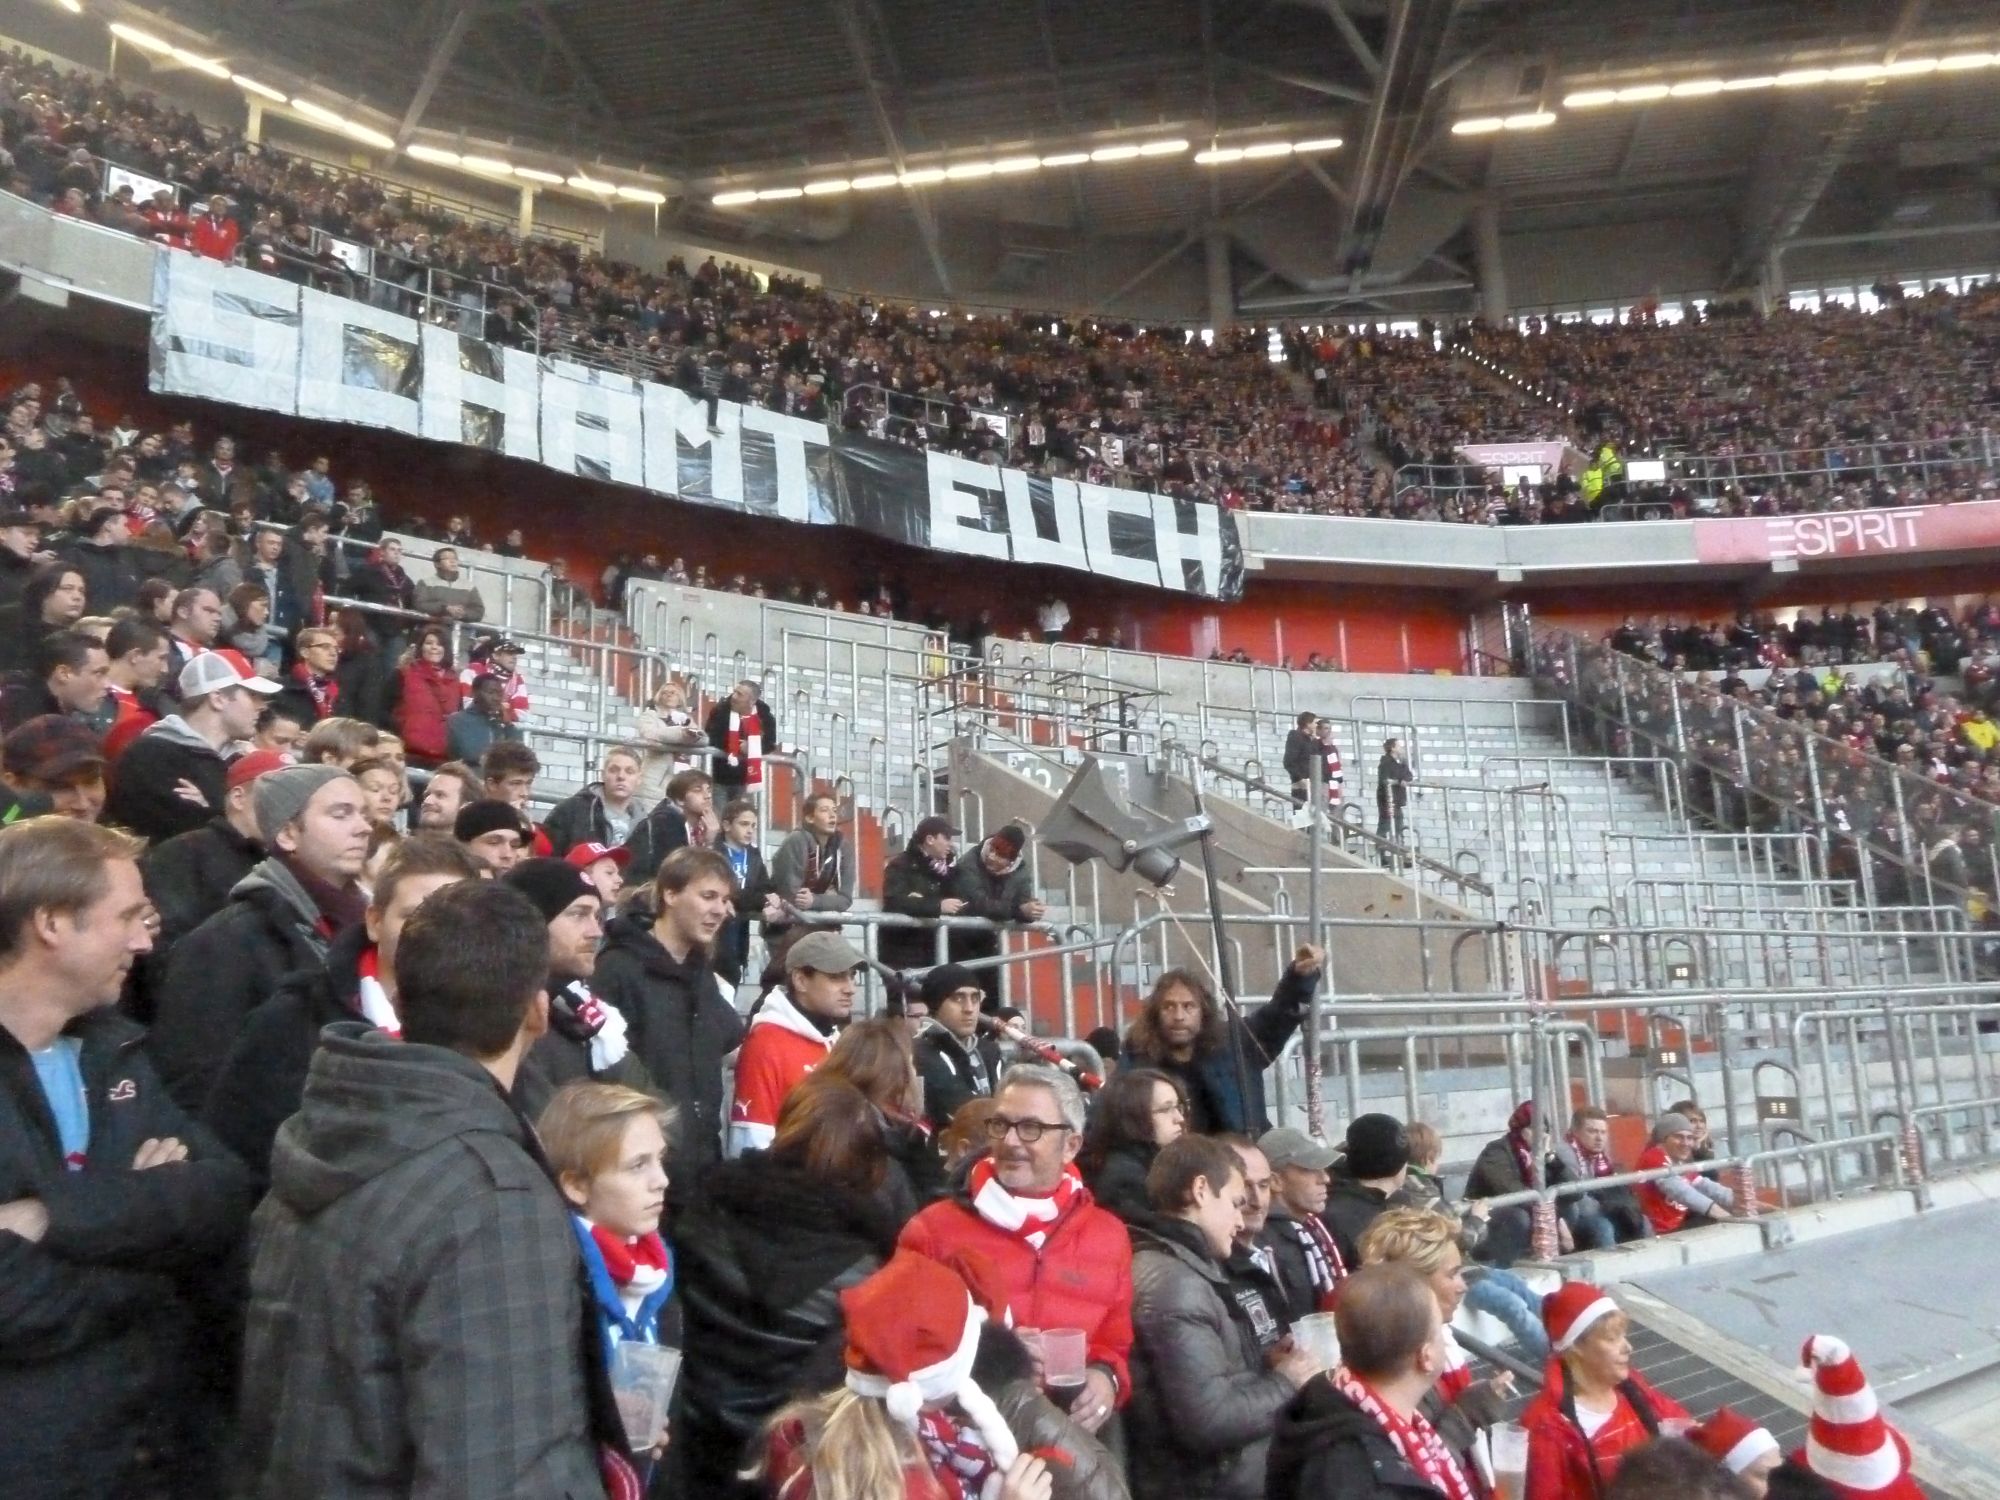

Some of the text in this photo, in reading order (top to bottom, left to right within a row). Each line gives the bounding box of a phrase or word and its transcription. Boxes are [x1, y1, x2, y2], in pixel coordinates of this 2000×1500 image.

[1480, 450, 1547, 464] ESPRIT
[927, 450, 1222, 597] EUCH
[1766, 511, 1923, 557] ESPRIT
